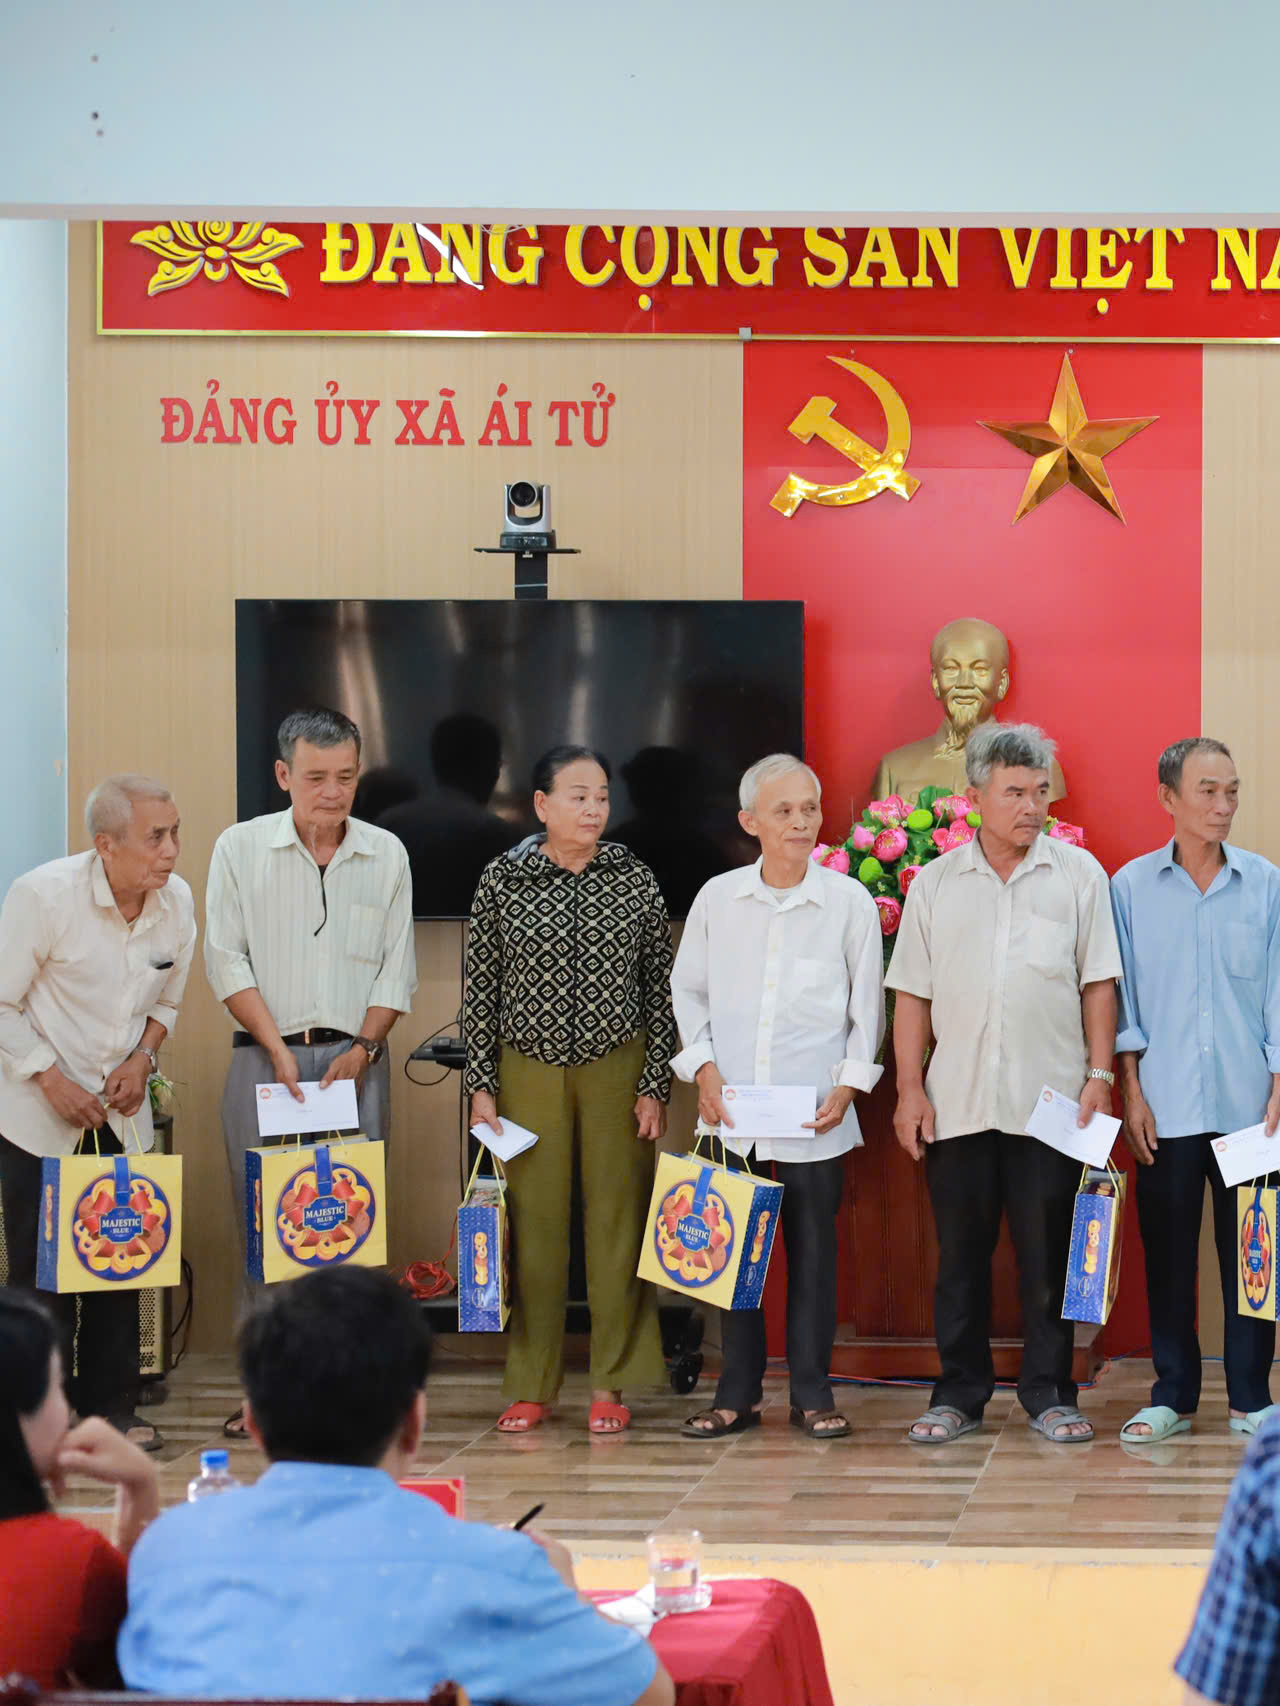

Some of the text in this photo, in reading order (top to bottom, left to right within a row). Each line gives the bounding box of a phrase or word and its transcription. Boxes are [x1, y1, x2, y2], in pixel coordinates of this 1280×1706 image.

[159, 379, 617, 447] ĐẢNG ỦY XÃ ÁI TỬ
[305, 1205, 345, 1219] MAJESTIC
[101, 1217, 141, 1228] MAJESTIC
[677, 1222, 709, 1240] MAJESTIC
